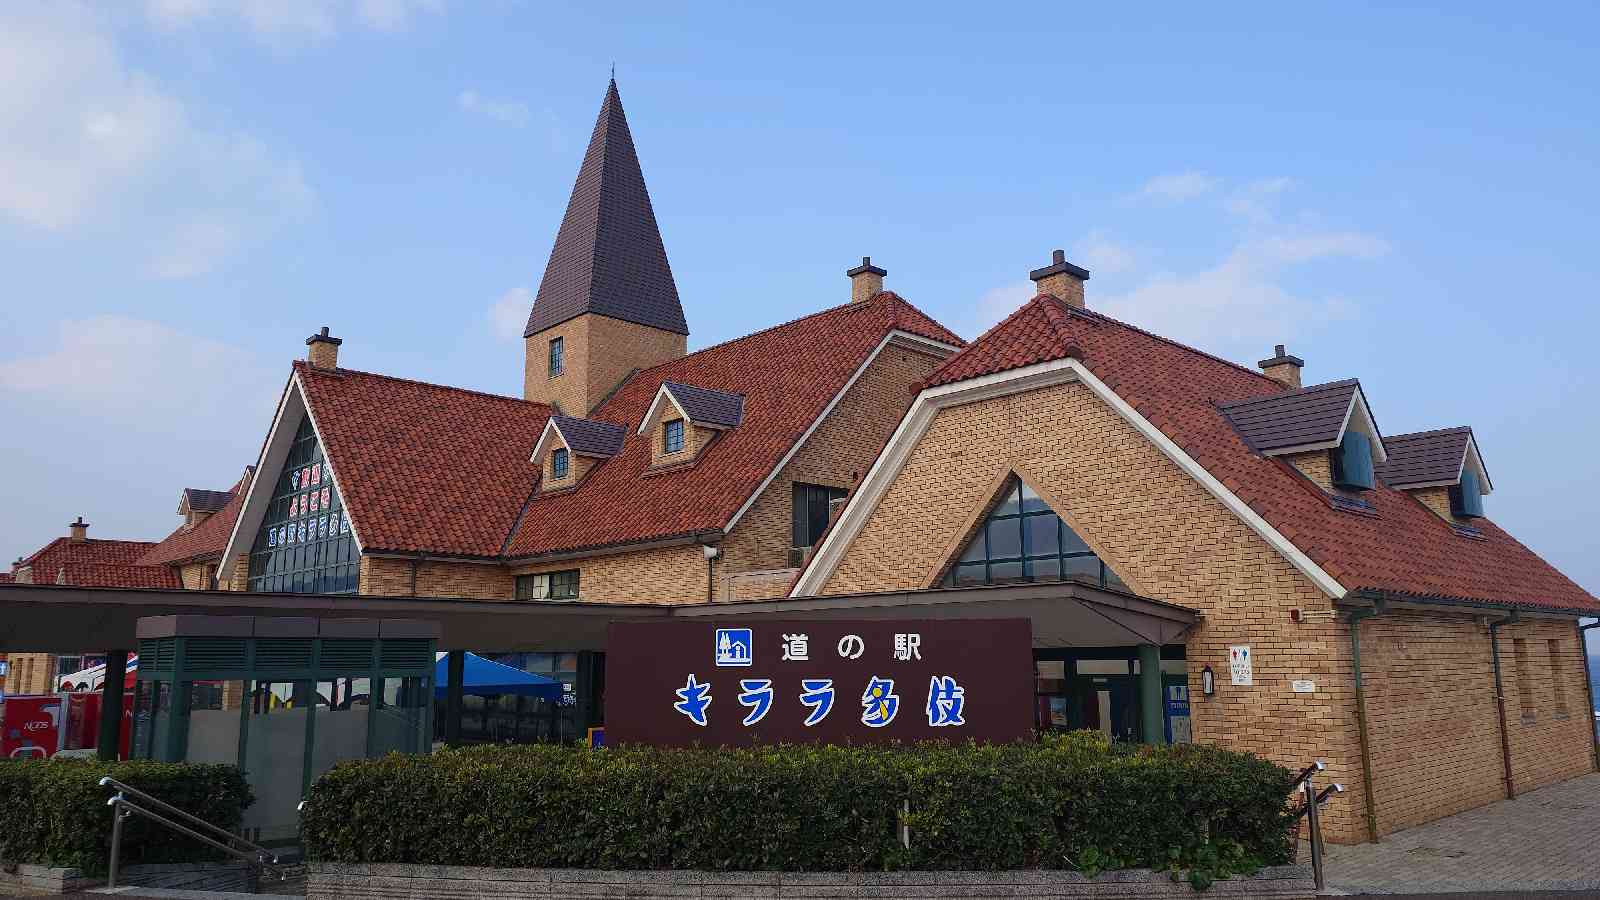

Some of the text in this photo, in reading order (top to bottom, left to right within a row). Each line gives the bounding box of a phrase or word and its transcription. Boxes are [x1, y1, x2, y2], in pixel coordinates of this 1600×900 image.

[289, 487, 330, 518] ようこそ
[781, 633, 922, 661] 道の駅
[673, 673, 966, 728] キララ多伎
